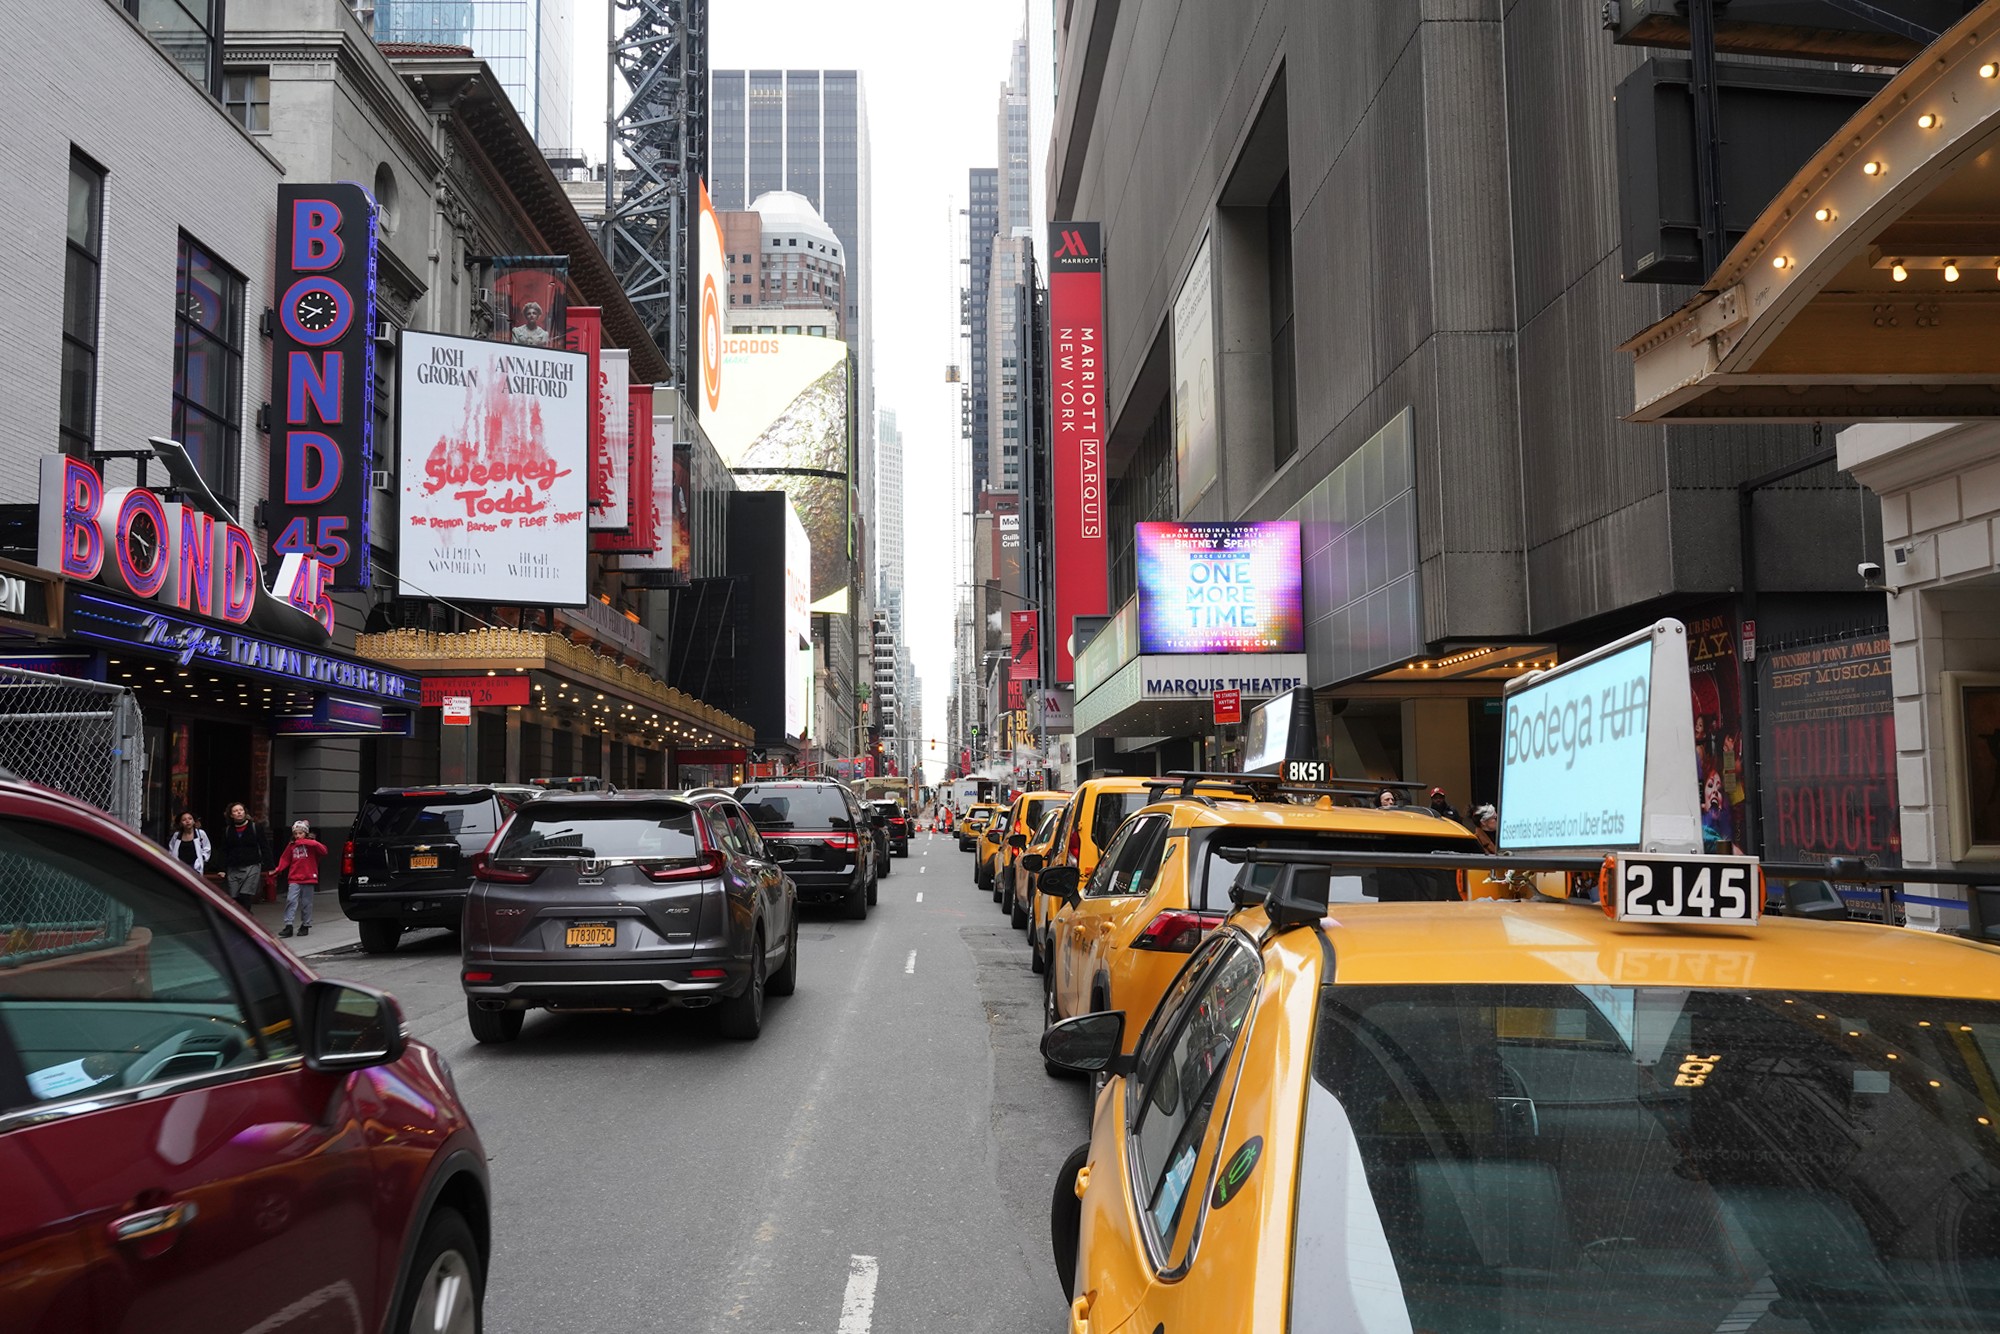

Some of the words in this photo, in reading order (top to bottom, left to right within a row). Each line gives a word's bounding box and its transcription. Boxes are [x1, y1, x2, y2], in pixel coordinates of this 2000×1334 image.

[280, 199, 353, 505] BOND
[431, 346, 464, 368] JOSH
[1060, 328, 1073, 371] NEW
[417, 363, 478, 388] GROBAN
[495, 356, 574, 381] ANNALEIGH
[1081, 328, 1097, 434] MARRIOTT
[501, 375, 568, 399] ASHFORD
[1061, 380, 1076, 432] YORK
[423, 458, 572, 495] Sweeney
[1083, 443, 1098, 536] MARQUIS
[454, 485, 545, 517] Todd
[60, 453, 257, 625] BOND
[467, 521, 497, 532] Barber
[272, 516, 349, 567] 45
[1174, 538, 1218, 548] BRITNEY
[1223, 538, 1264, 549] SPEARS
[1189, 562, 1251, 583] ONE
[287, 554, 335, 636] 45
[1186, 586, 1255, 604] MORE
[1186, 606, 1257, 627] TIME
[231, 636, 301, 675] ITALIAN
[306, 655, 368, 690] KITCHEN
[369, 671, 380, 692] &
[382, 673, 406, 698] BAR
[1822, 646, 1848, 662] TONY
[1147, 678, 1225, 695] MARQUIS
[1772, 672, 1811, 689] BEST
[480, 689, 493, 702] 26
[1507, 692, 1593, 771] Bodega
[1599, 675, 1648, 743] run
[1773, 717, 1877, 782] MOULIN
[1289, 762, 1325, 781] 8K51
[1502, 817, 1532, 840] Essentials
[1532, 814, 1567, 838] delivered
[1567, 819, 1579, 836] on
[1579, 811, 1600, 836] Uber
[1601, 809, 1625, 835] Eats
[1627, 864, 1746, 918] 2J45
[570, 928, 612, 942] T783075C
